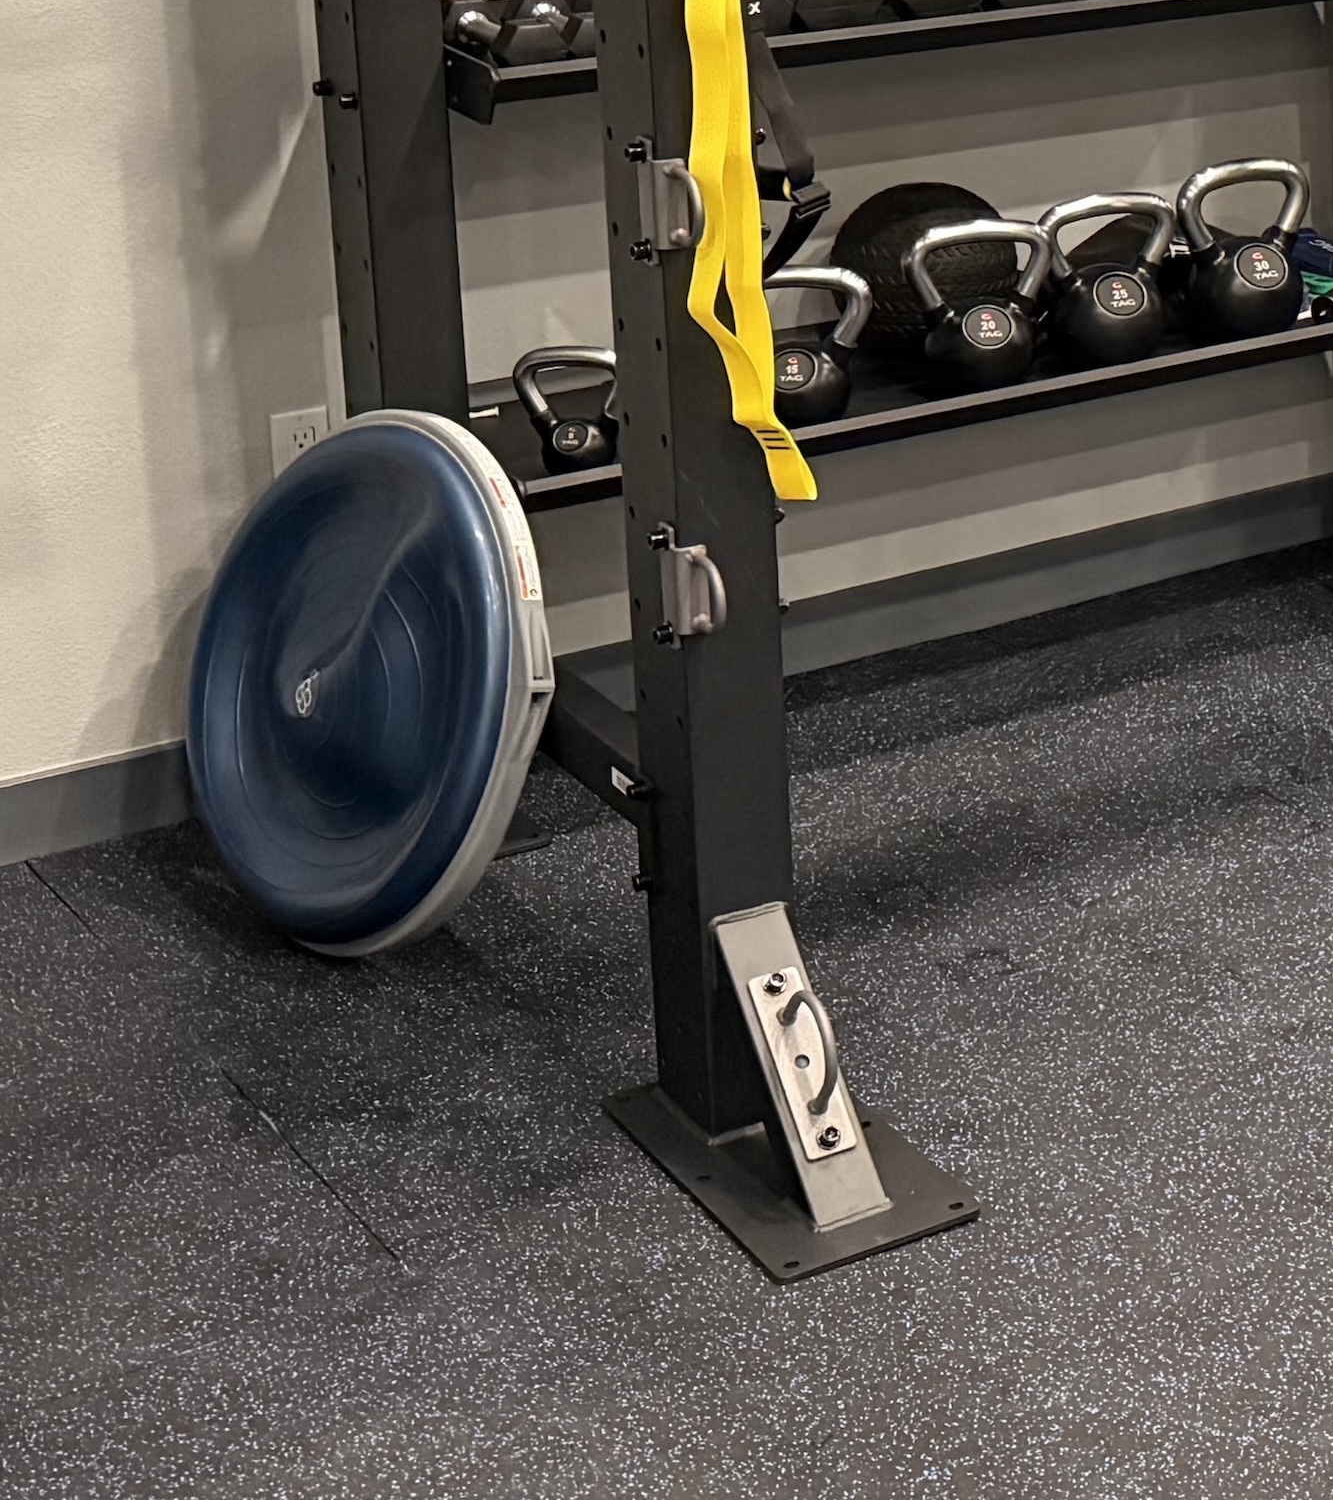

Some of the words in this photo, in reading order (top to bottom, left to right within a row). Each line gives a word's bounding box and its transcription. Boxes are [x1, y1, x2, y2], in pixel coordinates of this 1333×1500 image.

[1253, 260, 1270, 271] 30
[1253, 270, 1279, 280] TAG
[1112, 289, 1128, 300] 25
[1110, 298, 1136, 308] TAG
[980, 320, 996, 331] 20
[978, 330, 1003, 339] TAG
[785, 364, 799, 375] 15
[779, 374, 804, 382] TAG
